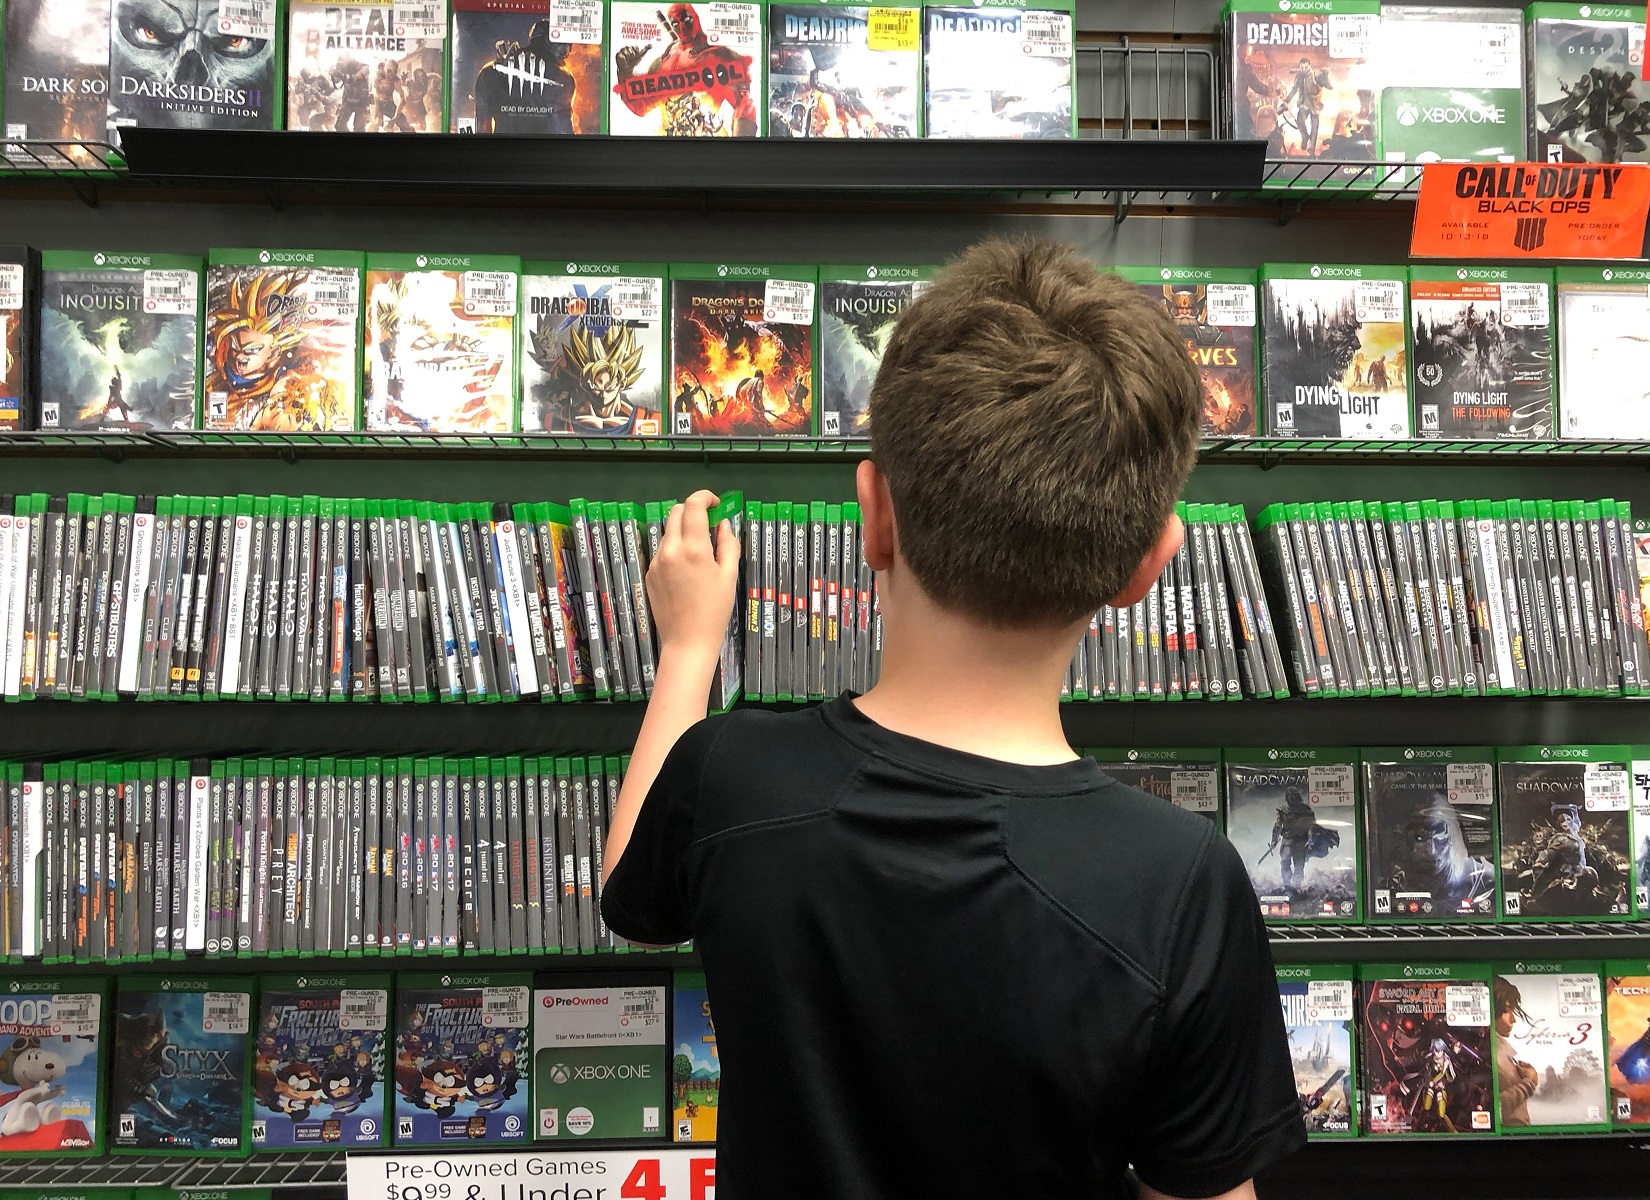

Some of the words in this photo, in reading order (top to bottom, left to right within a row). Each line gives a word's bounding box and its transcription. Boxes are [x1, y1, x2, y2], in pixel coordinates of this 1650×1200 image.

[326, 36, 405, 51] ALLIANCE
[622, 27, 661, 36] AWESOME
[22, 77, 76, 93] DARK
[120, 76, 247, 105] DARKSIDERS
[629, 63, 742, 95] DEADPOOL
[211, 105, 258, 117] EDITION
[1455, 167, 1526, 198] CALL
[1525, 175, 1536, 186] OF
[1536, 168, 1623, 199] DUTY
[1478, 201, 1543, 213] BLACK
[1550, 201, 1590, 213] OPS
[864, 288, 896, 297] DRAGON
[1426, 368, 1434, 376] 50
[1296, 386, 1339, 406] DYING
[1340, 396, 1380, 418] LIGHT
[1454, 392, 1480, 405] DYING
[1482, 392, 1508, 405] LIGHT
[1452, 408, 1466, 418] THE
[1469, 408, 1511, 419] FOLLOWING
[106, 580, 123, 658] GHOSTBUSTERS
[1164, 586, 1177, 636] MAFIA
[1180, 585, 1196, 635] MAFIA
[1236, 774, 1288, 786] SHADOW
[1516, 782, 1571, 794] SHADOW
[195, 798, 203, 818] Plants
[194, 830, 203, 860] Zombies
[260, 831, 268, 853] Portal
[289, 833, 297, 861] PRISON
[79, 837, 87, 886] PAYDAY
[108, 833, 116, 880] PAYDAY
[155, 841, 163, 871] PILLARS
[173, 842, 181, 873] PILLARS
[259, 854, 267, 884] Knights
[543, 837, 553, 882] RESIDENT
[172, 887, 180, 914] EARTH
[285, 862, 296, 924] ARCHITECT
[556, 996, 608, 1007] PreOwned
[1569, 1023, 1592, 1045] 3
[159, 1044, 236, 1080] STYX
[574, 1066, 616, 1080] XBOX
[617, 1065, 651, 1079] ONE
[121, 1121, 134, 1132] M
[385, 1158, 518, 1179] Pre-Owned
[525, 1157, 607, 1176] Games
[620, 1159, 667, 1200] 4
